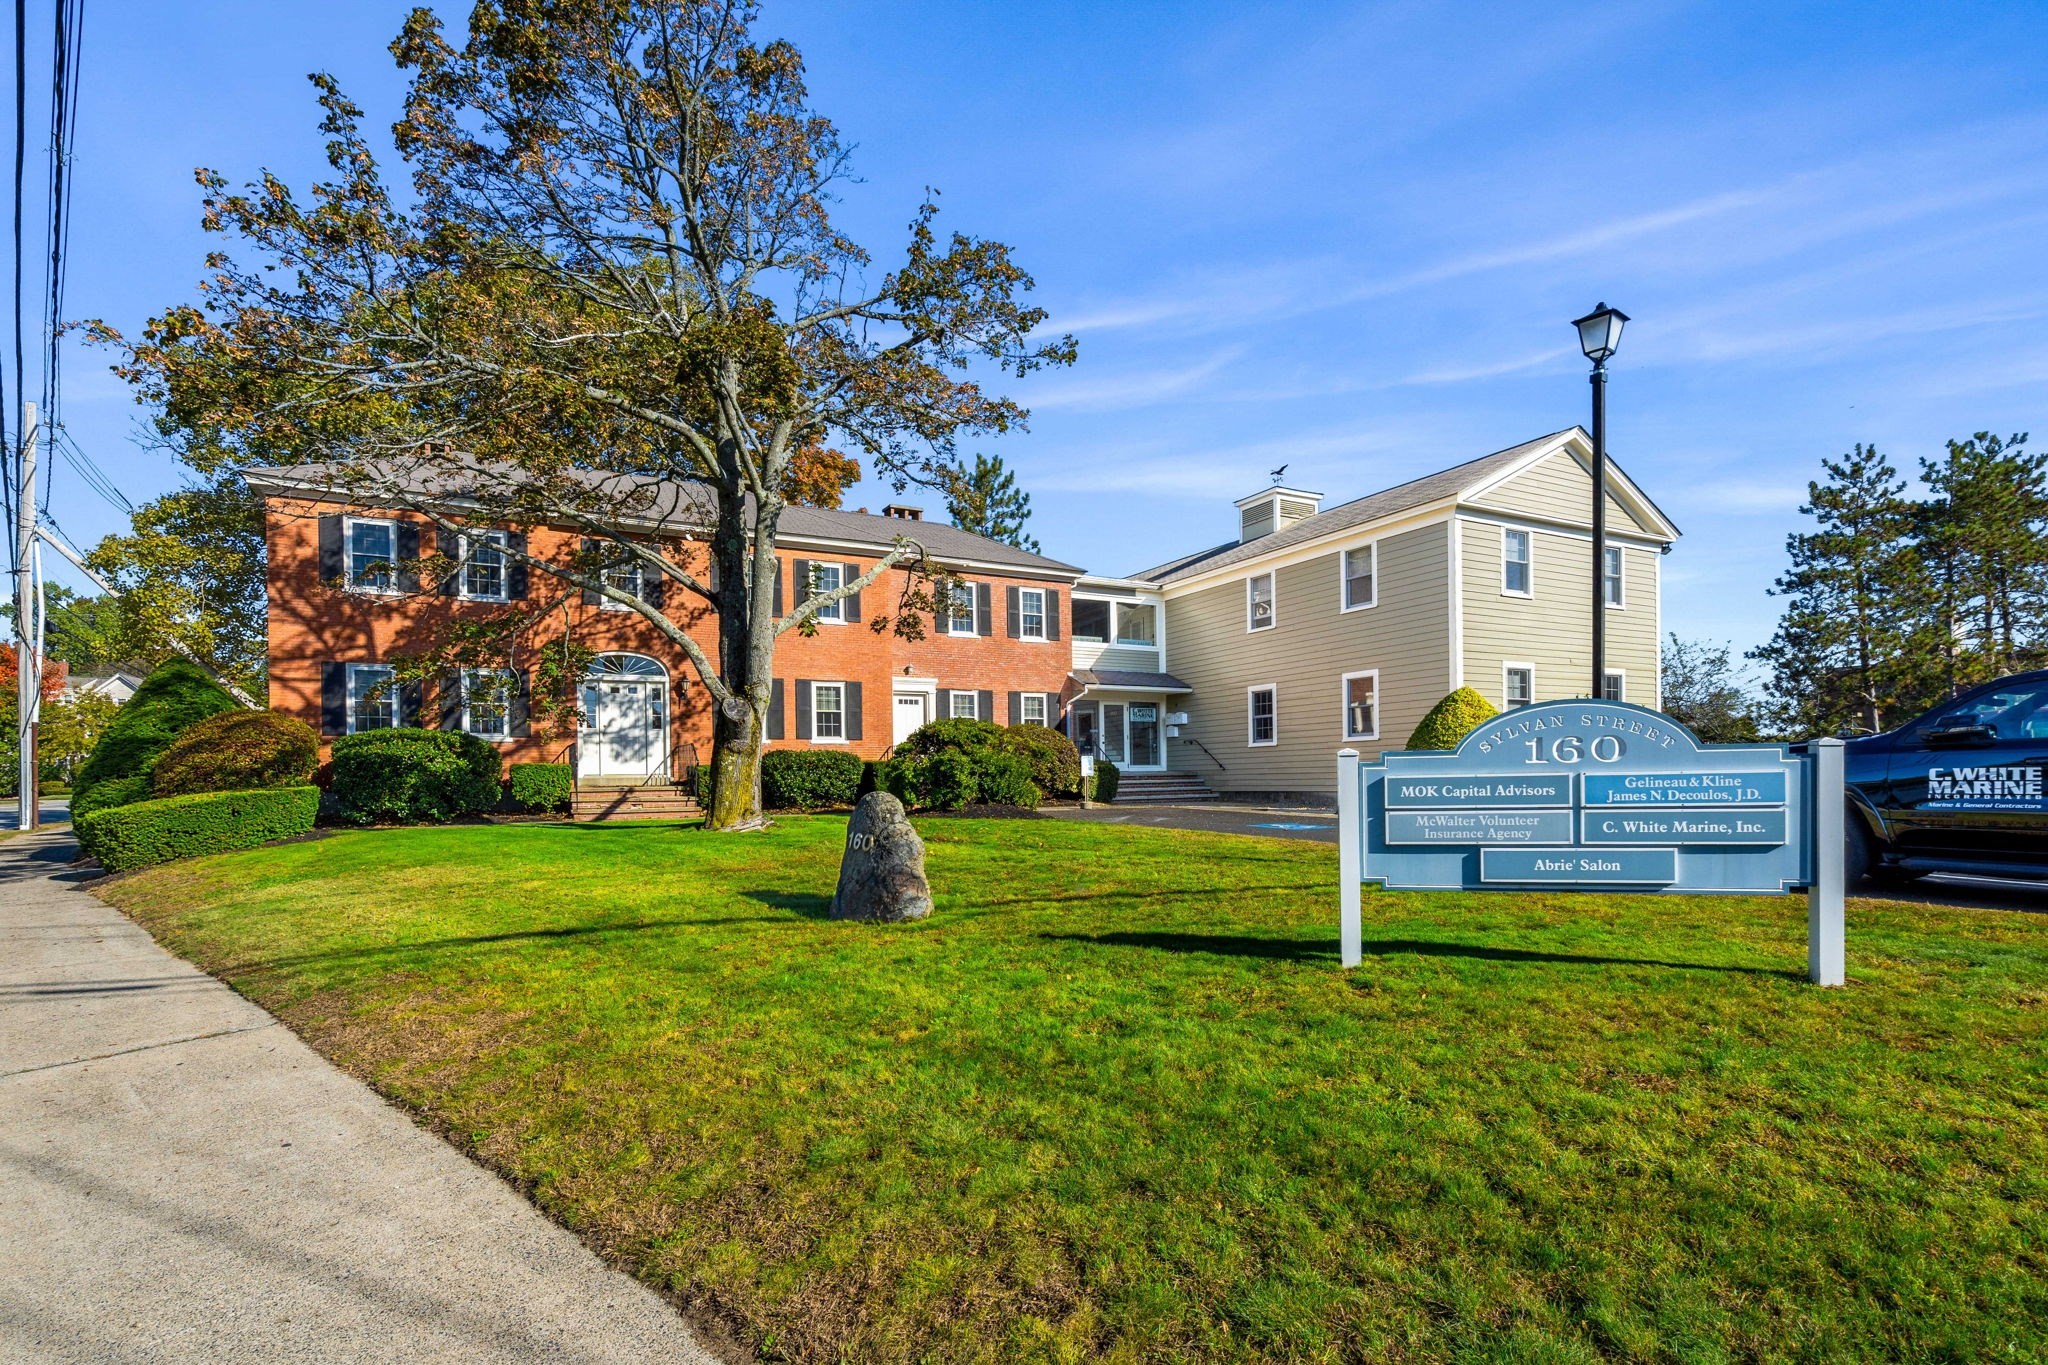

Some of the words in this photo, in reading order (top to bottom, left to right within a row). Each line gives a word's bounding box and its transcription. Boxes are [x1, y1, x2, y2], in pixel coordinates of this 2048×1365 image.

[1479, 715, 1565, 754] SYLVAN
[1581, 714, 1676, 749] STREET
[1525, 735, 1627, 764] 160
[1928, 767, 2043, 781] C.WHITE
[1625, 776, 1687, 788] Gelineau
[1689, 777, 1699, 788] &
[1702, 775, 1742, 787] Kline
[1928, 780, 2043, 795] MARINE
[1401, 786, 1439, 797] MOK
[1442, 785, 1491, 799] Capital
[1495, 785, 1556, 796] Advisors
[1606, 790, 1647, 803] James
[1650, 790, 1665, 801] N.
[1667, 789, 1732, 802] Decoulos,
[1735, 788, 1762, 802] J.D.
[1416, 815, 1476, 827] McWalter
[1479, 815, 1540, 826] Volunteer
[1602, 821, 1619, 833] C.
[1623, 821, 1668, 833] White
[1672, 821, 1733, 835] Marine,
[1736, 821, 1766, 833] Inc.
[1424, 828, 1484, 839] Insurance
[1487, 828, 1533, 841] Agency
[848, 832, 874, 852] 160
[1534, 859, 1576, 871] Abrie'
[1580, 859, 1621, 871] Salon
